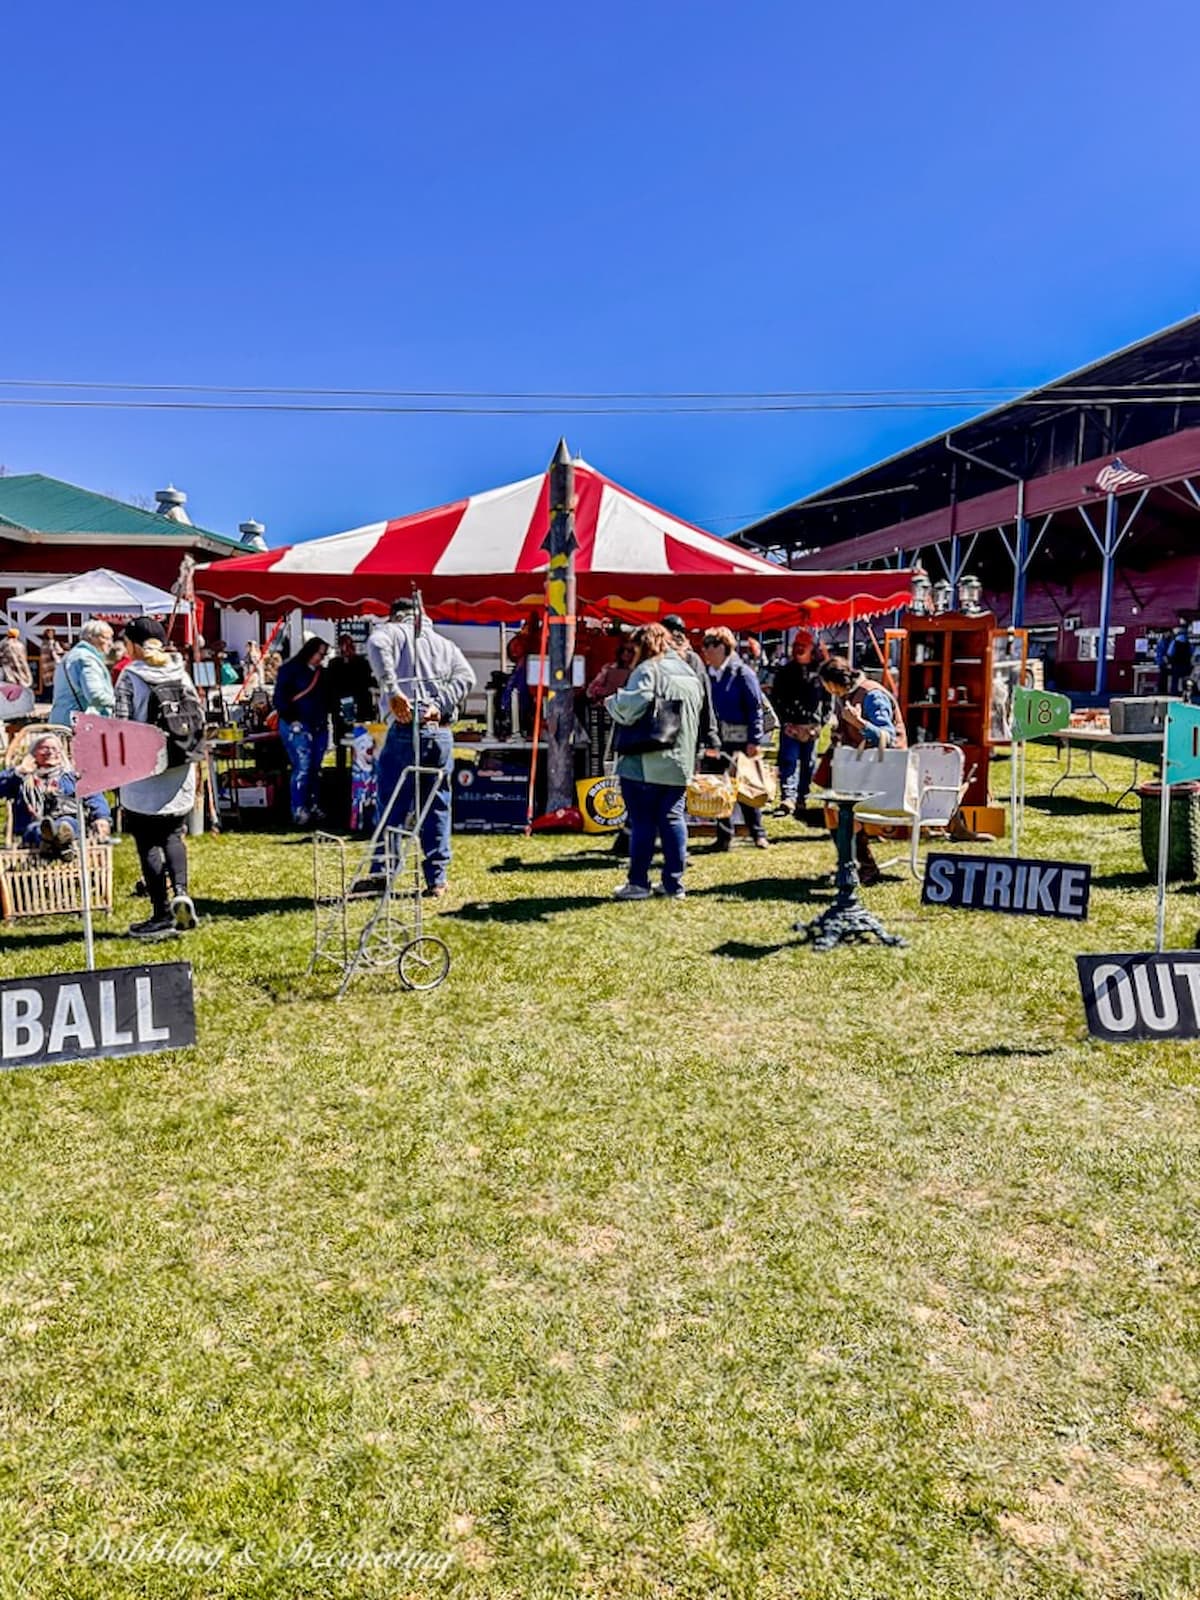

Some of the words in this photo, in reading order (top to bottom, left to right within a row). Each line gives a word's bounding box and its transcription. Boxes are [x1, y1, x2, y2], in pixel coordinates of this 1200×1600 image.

[1027, 699, 1053, 725] 18
[100, 731, 126, 768] 11
[926, 859, 1087, 915] STRIKE
[1, 976, 170, 1059] BALL
[1092, 963, 1200, 1033] OUT
